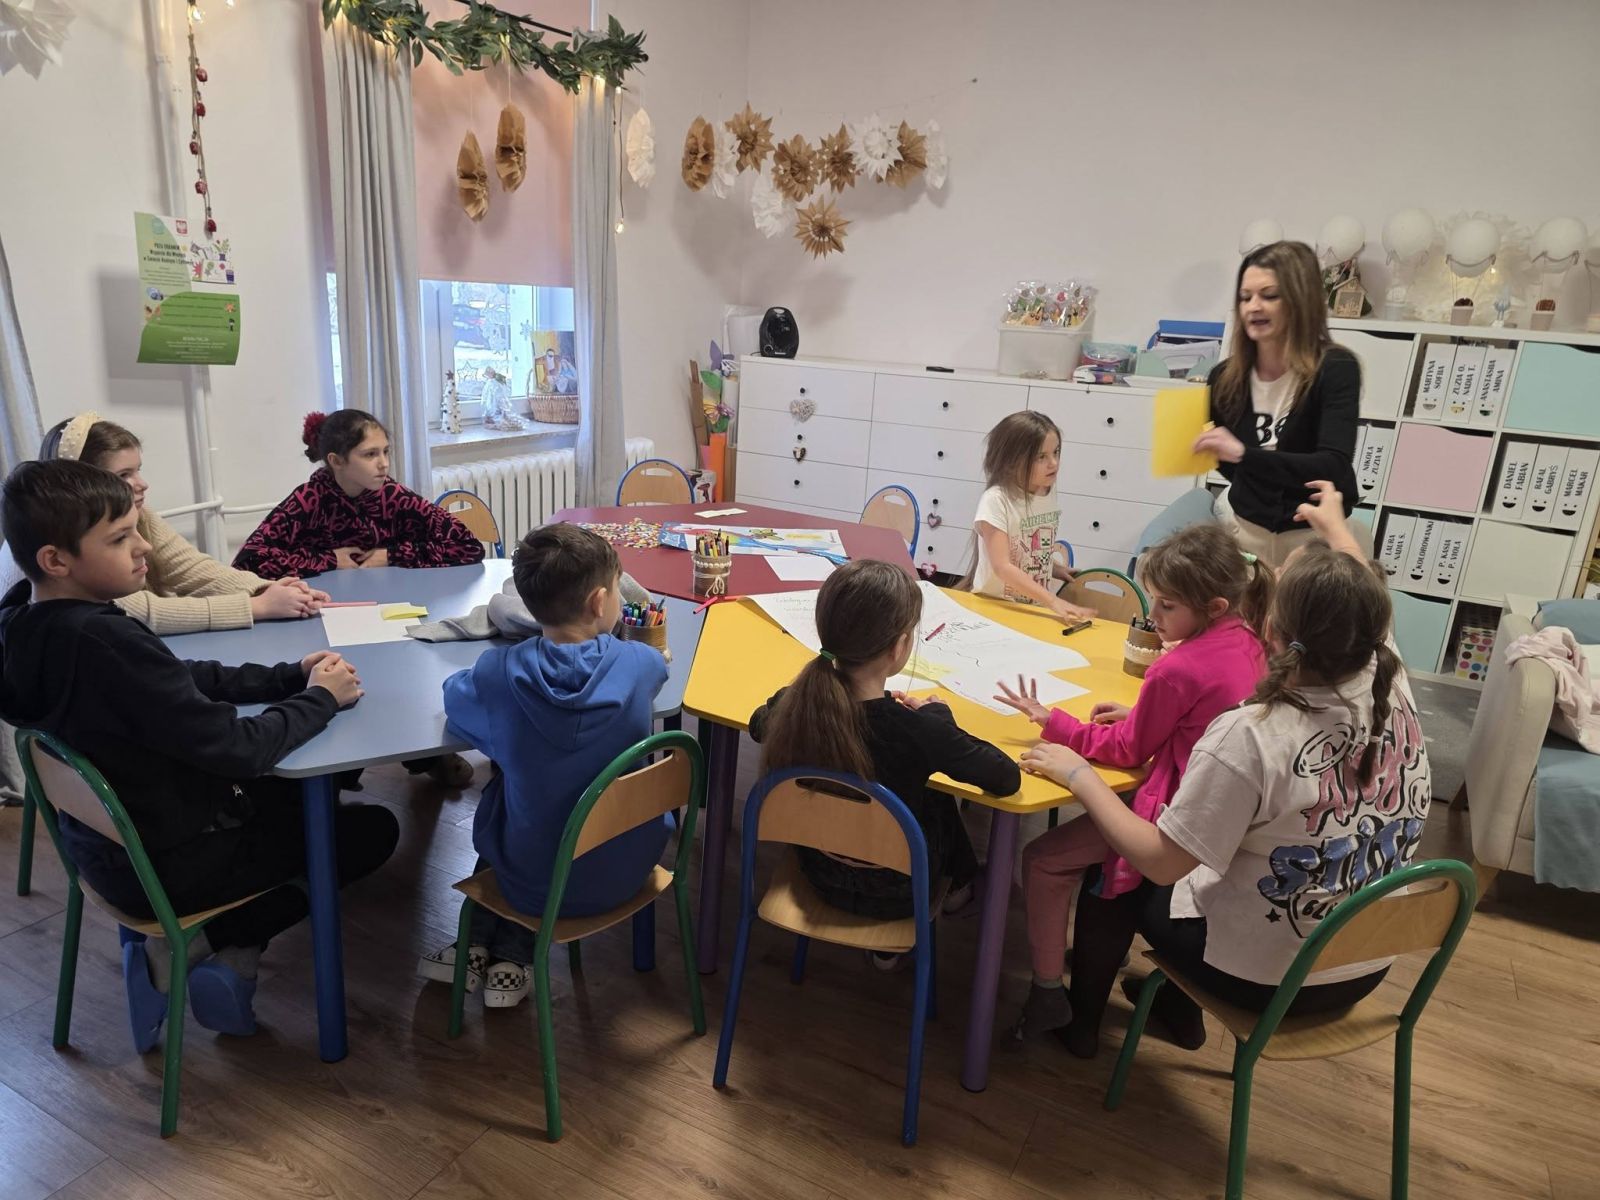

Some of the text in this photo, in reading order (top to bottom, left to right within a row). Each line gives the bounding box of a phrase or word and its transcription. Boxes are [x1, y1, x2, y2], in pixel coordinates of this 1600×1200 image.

[1504, 462, 1518, 490] DANIEL
[1514, 462, 1529, 490] FABIAN
[1564, 468, 1578, 498] MARCEL
